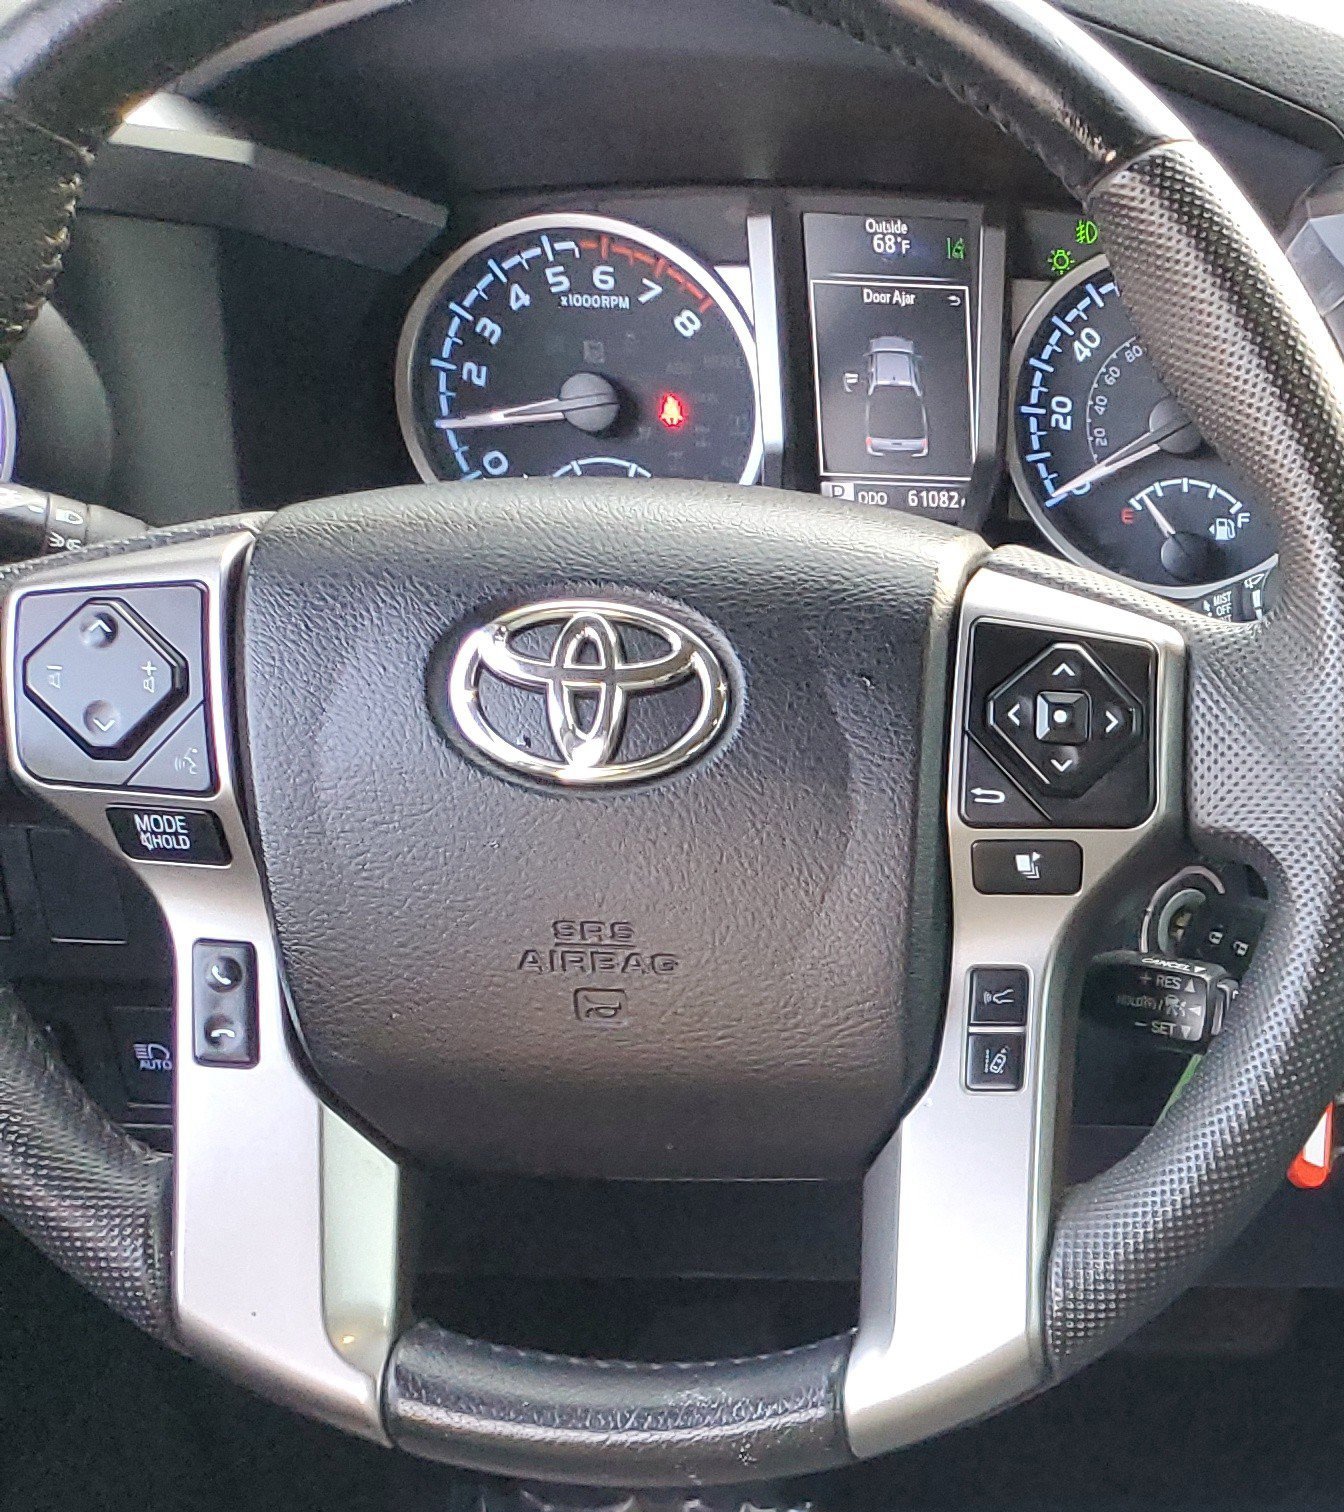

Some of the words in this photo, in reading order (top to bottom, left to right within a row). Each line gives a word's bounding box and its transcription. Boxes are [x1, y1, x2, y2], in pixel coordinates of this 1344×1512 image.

[865, 217, 908, 237] Outside
[544, 265, 571, 293] 5
[592, 265, 615, 291] 6
[509, 283, 531, 311] 4
[637, 277, 663, 304] 7
[862, 287, 892, 304] Door
[892, 289, 916, 307] Ajar
[474, 316, 502, 345] 3
[673, 310, 702, 338] 8
[1071, 327, 1101, 363] 40
[461, 361, 487, 387] 2
[1103, 366, 1121, 386] 60
[1050, 396, 1073, 431] 20
[1093, 395, 1108, 416] 40
[1093, 427, 1108, 447] 20
[482, 450, 509, 476] 0
[857, 491, 888, 506] ODO
[907, 489, 960, 509] 61082
[1121, 508, 1133, 524] E
[1236, 512, 1251, 529] F
[1216, 602, 1232, 617] OFF
[134, 813, 189, 833] MODE
[152, 834, 191, 849] HOLD
[551, 919, 635, 943] SRS
[517, 949, 680, 975] AIRBAG
[1141, 957, 1191, 972] CANCEL
[1156, 975, 1182, 990] RES
[1151, 1021, 1177, 1037] SET
[139, 1059, 173, 1071] AUTO
